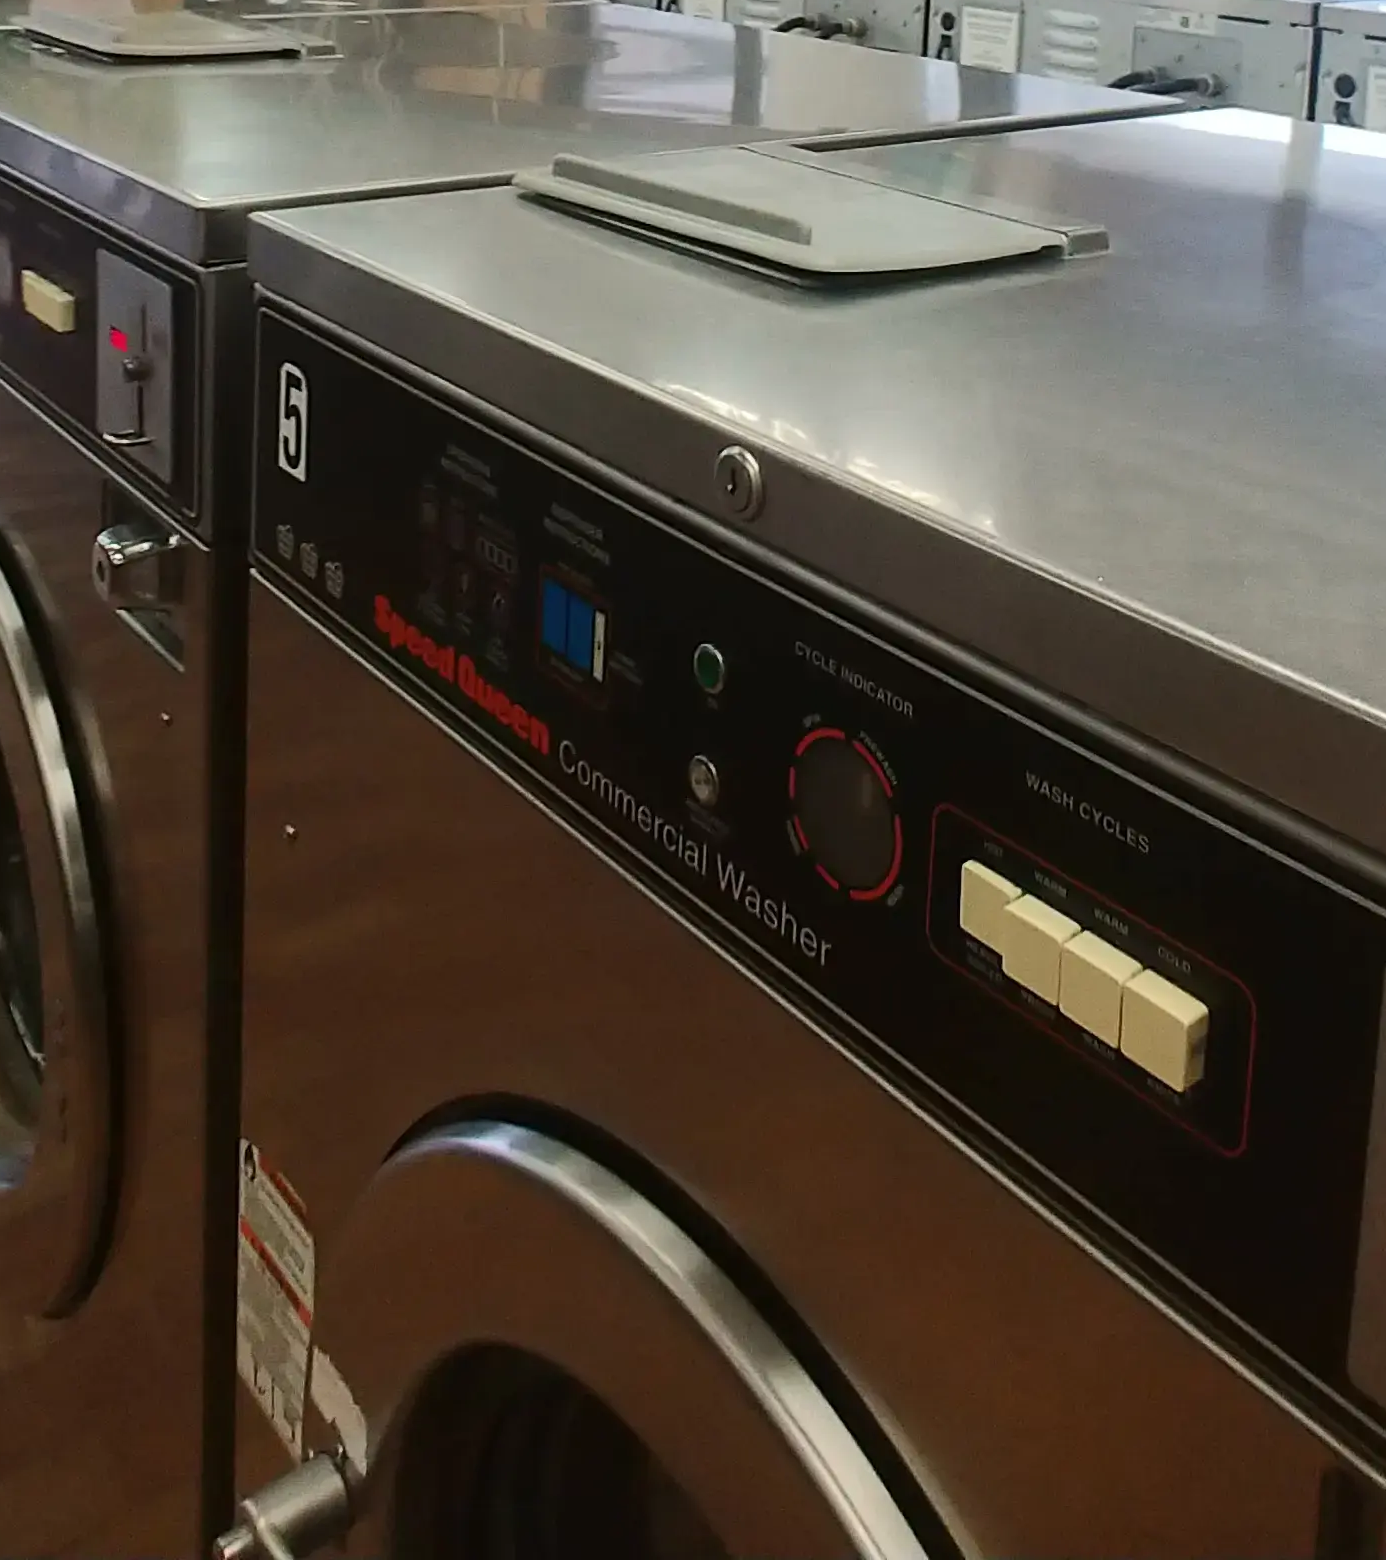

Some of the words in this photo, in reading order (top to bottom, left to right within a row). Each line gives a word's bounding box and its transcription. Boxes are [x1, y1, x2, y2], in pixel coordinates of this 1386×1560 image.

[281, 367, 306, 476] 5
[374, 594, 455, 684] Speed
[457, 654, 550, 755] Queen
[795, 641, 836, 675] CYCLE
[841, 665, 913, 718] INDICATOR
[559, 740, 708, 877] Commercial
[716, 853, 832, 967] Washer
[1025, 770, 1075, 811] WASH
[1079, 801, 1150, 854] CYCLES
